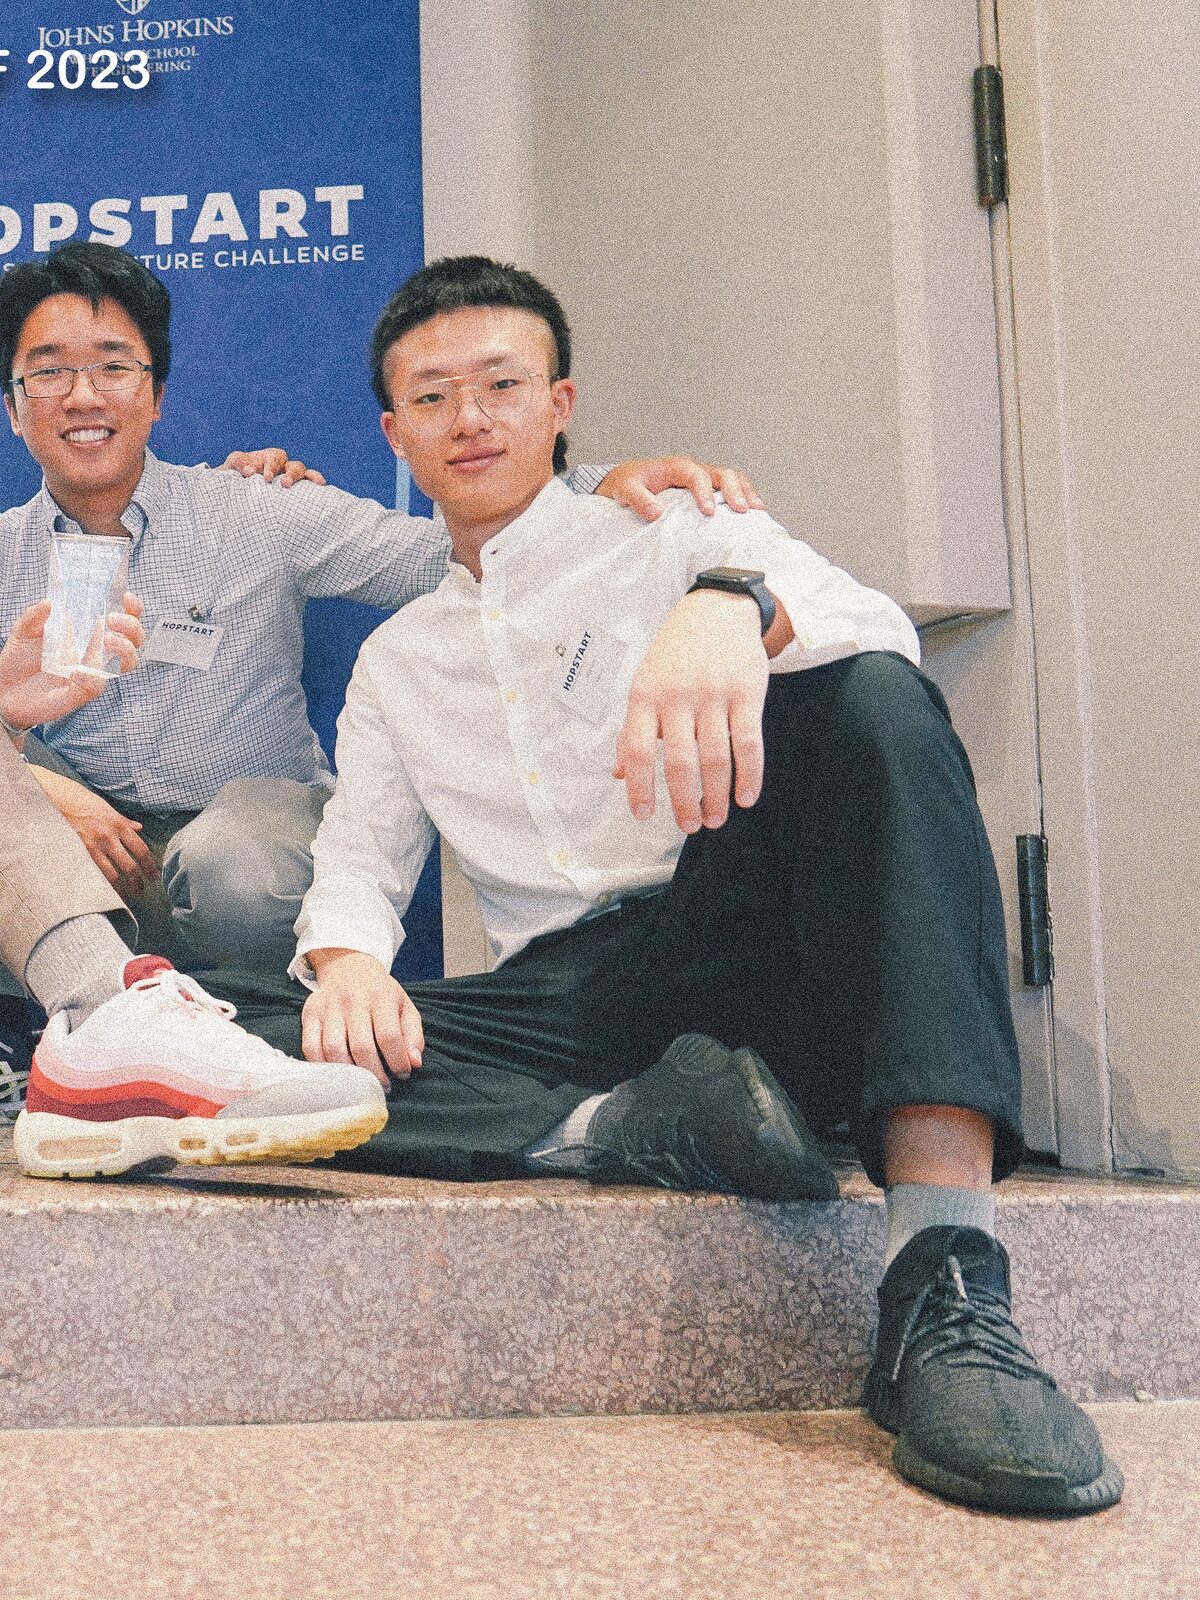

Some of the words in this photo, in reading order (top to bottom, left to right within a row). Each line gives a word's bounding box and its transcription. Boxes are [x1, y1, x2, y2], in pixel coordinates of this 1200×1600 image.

[38, 24, 115, 50] JOHNS
[121, 15, 235, 43] HOPKINS
[143, 45, 200, 60] CHOOL
[213, 243, 365, 268] CHALLENGE
[161, 622, 215, 636] HOPSTART
[562, 631, 592, 691] HOPSTART
